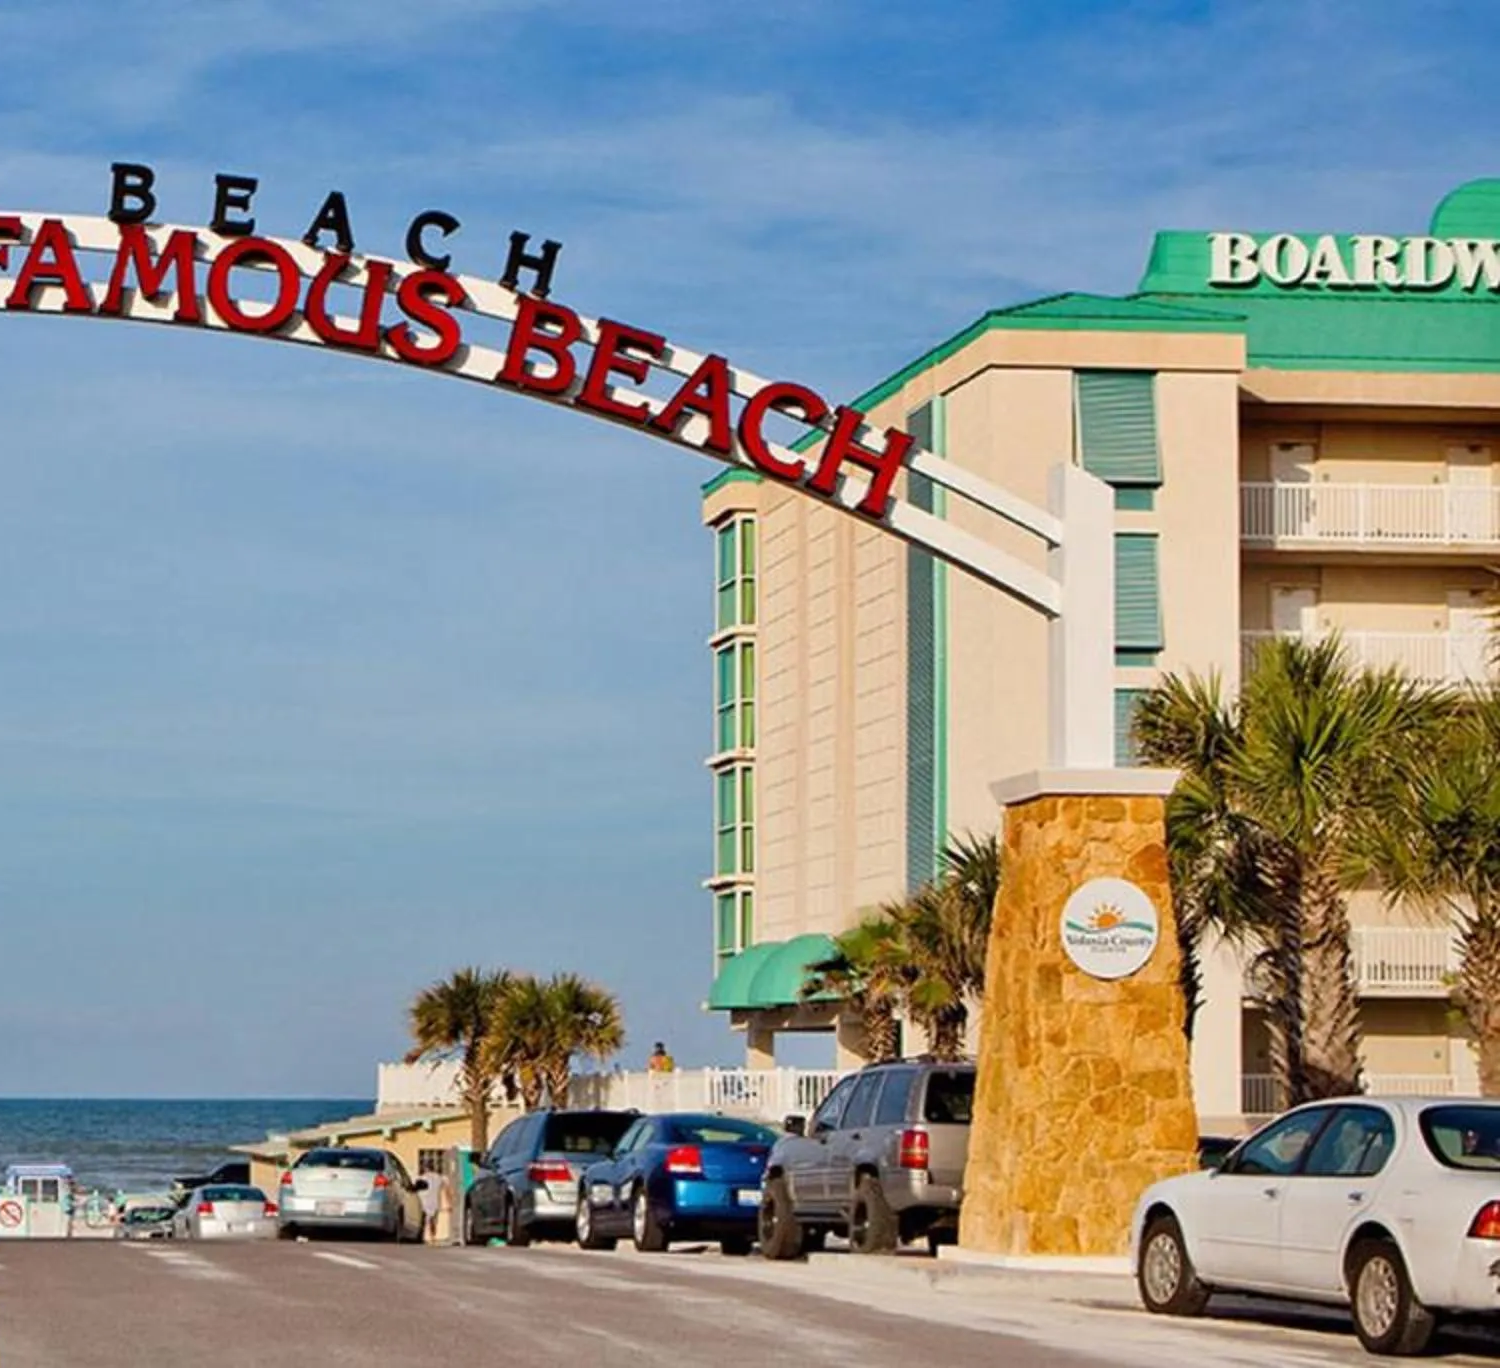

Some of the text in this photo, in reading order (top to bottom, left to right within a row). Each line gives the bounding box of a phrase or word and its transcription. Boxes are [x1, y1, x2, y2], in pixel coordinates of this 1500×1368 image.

[106, 162, 563, 297] BEACH
[1206, 232, 1500, 291] BOARDW
[496, 295, 916, 518] BEACH
